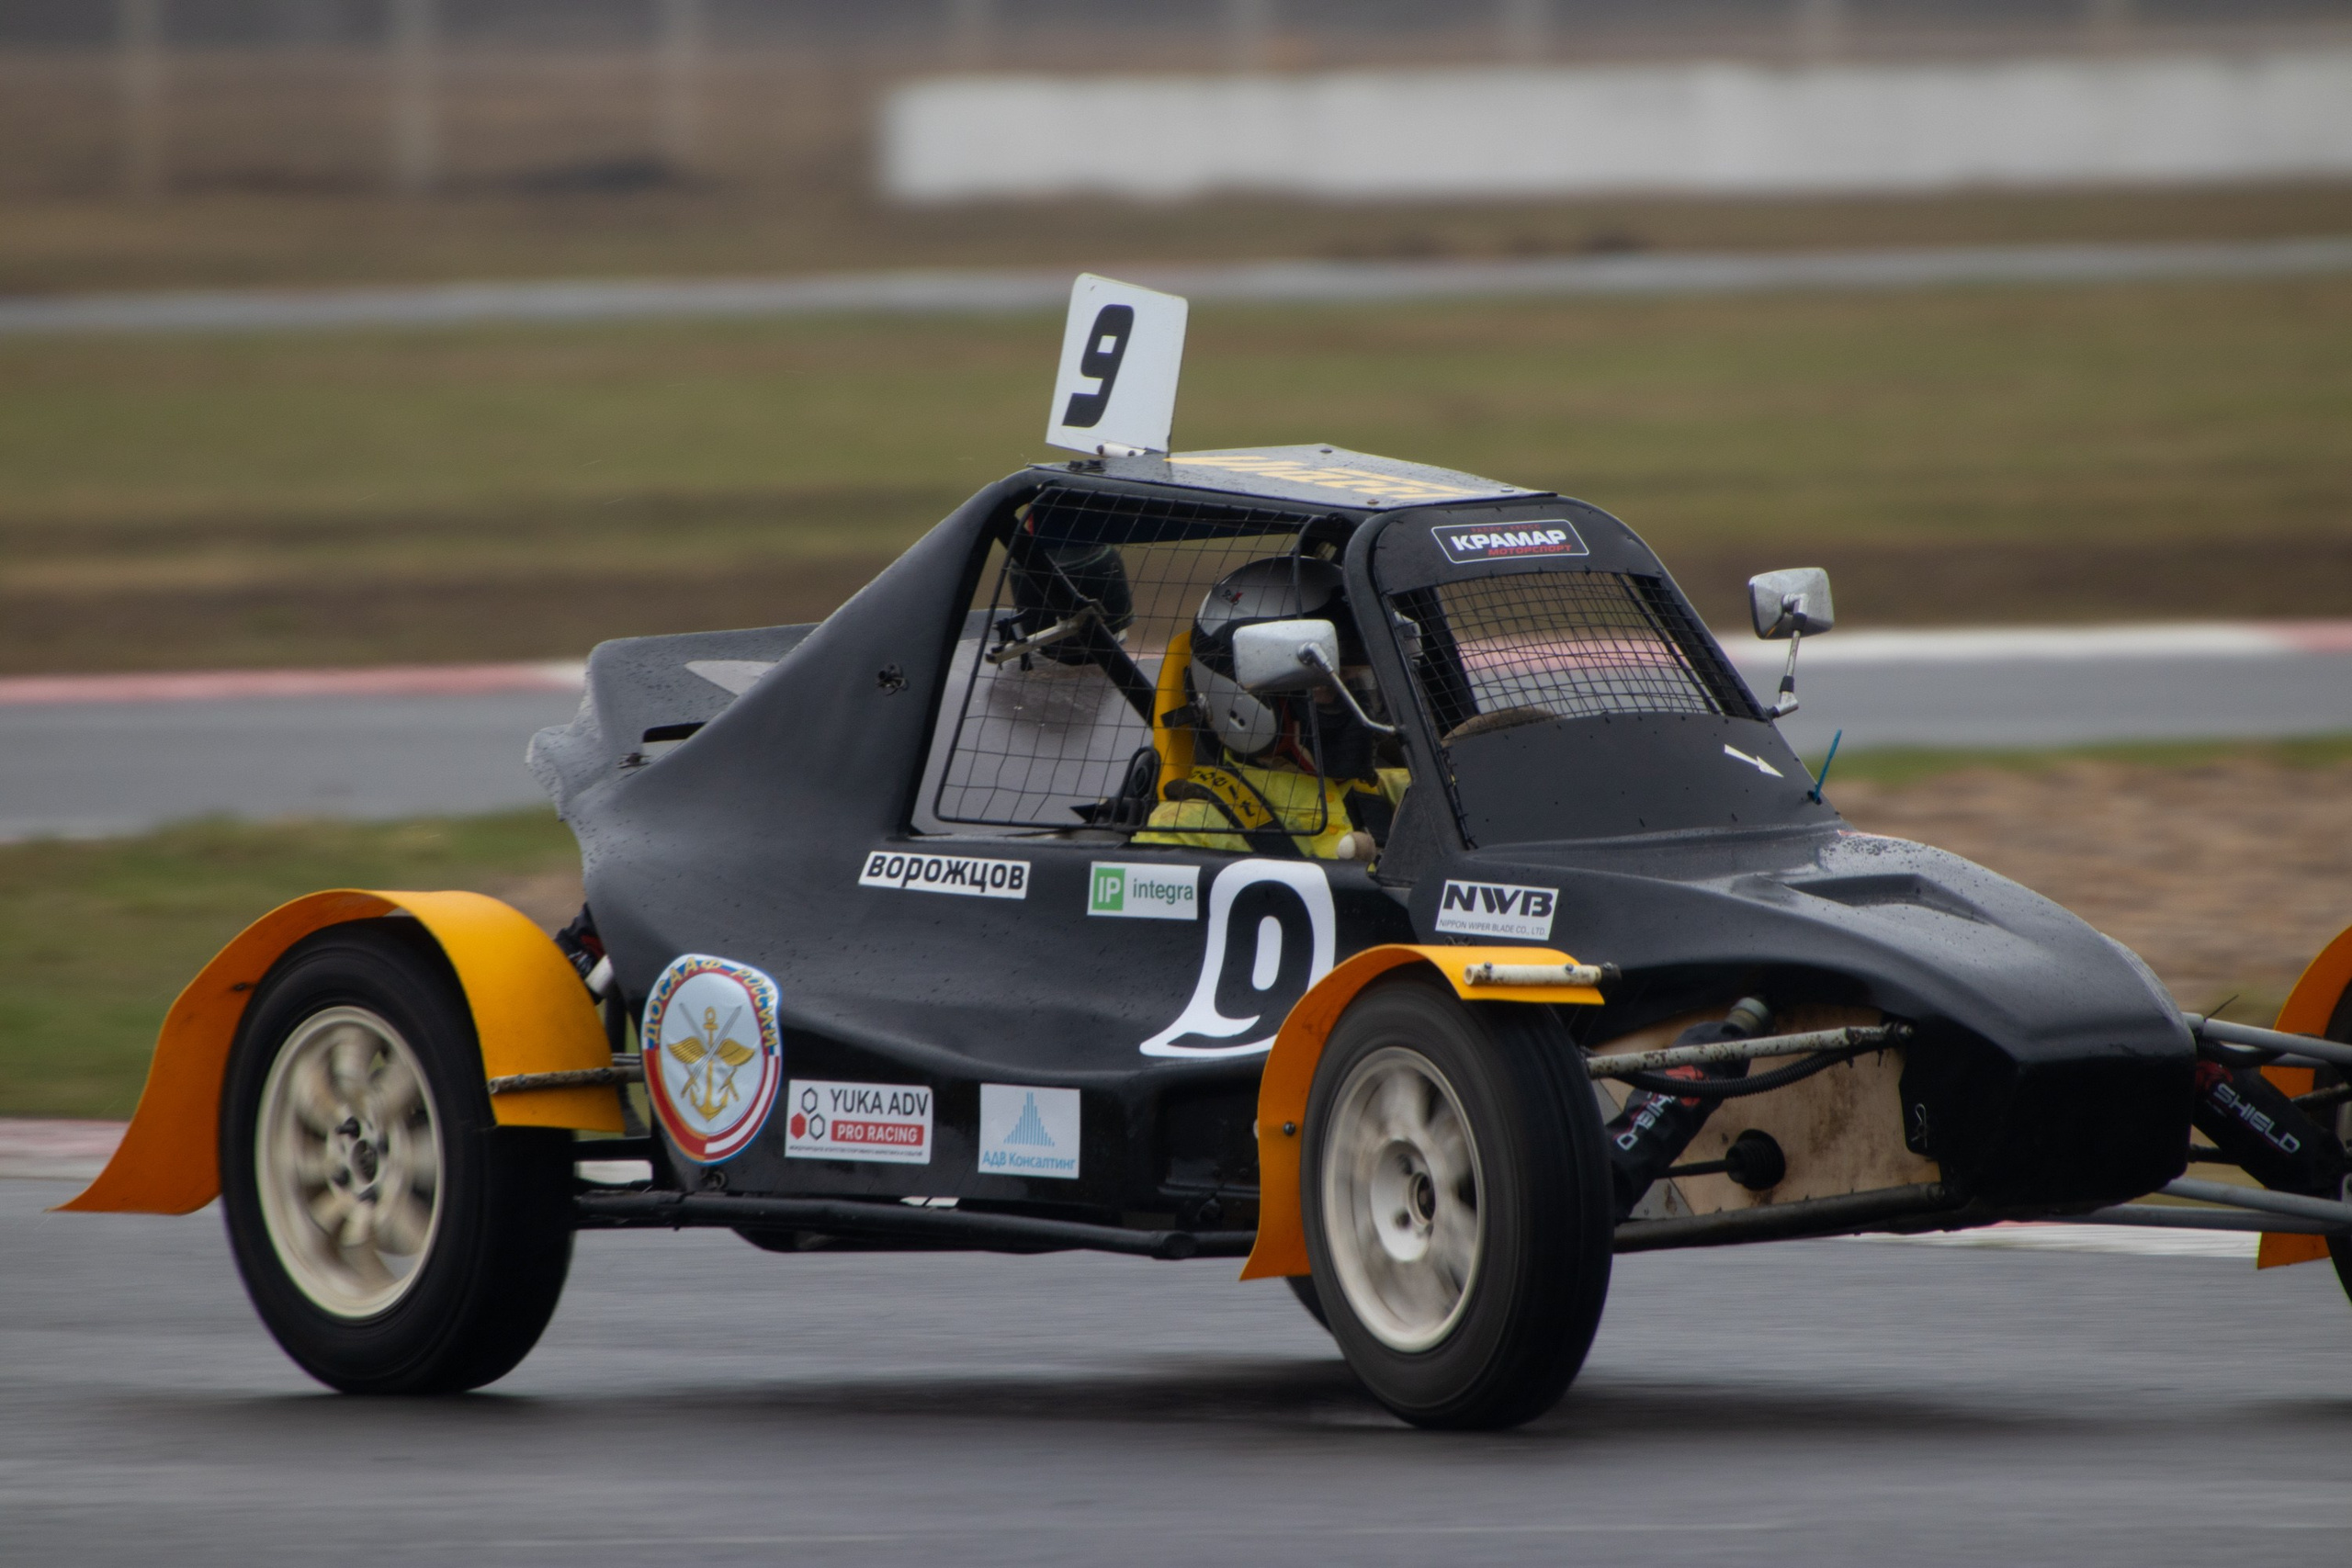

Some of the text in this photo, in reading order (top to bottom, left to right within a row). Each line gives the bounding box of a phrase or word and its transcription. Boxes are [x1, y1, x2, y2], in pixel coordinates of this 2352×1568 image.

[1061, 303, 1135, 429] 9
[1450, 529, 1567, 551] КРАМАР
[1487, 544, 1573, 557] МОТОРСПОРТ
[1098, 875, 1193, 906] IP integra
[1442, 884, 1554, 918] NWB
[1439, 919, 1467, 929] NIPPON
[1468, 921, 1490, 931] WIPER
[1491, 923, 1514, 933] BLADE
[644, 956, 777, 1047] ДОСААФ РОССИИ
[831, 1089, 929, 1117] YUKA ADV
[1616, 1089, 1677, 1150] HIELD
[2212, 1083, 2301, 1154] SHIELD
[837, 1123, 918, 1144] PRO RACING
[982, 1150, 1077, 1171] АДВ Консалтинг
